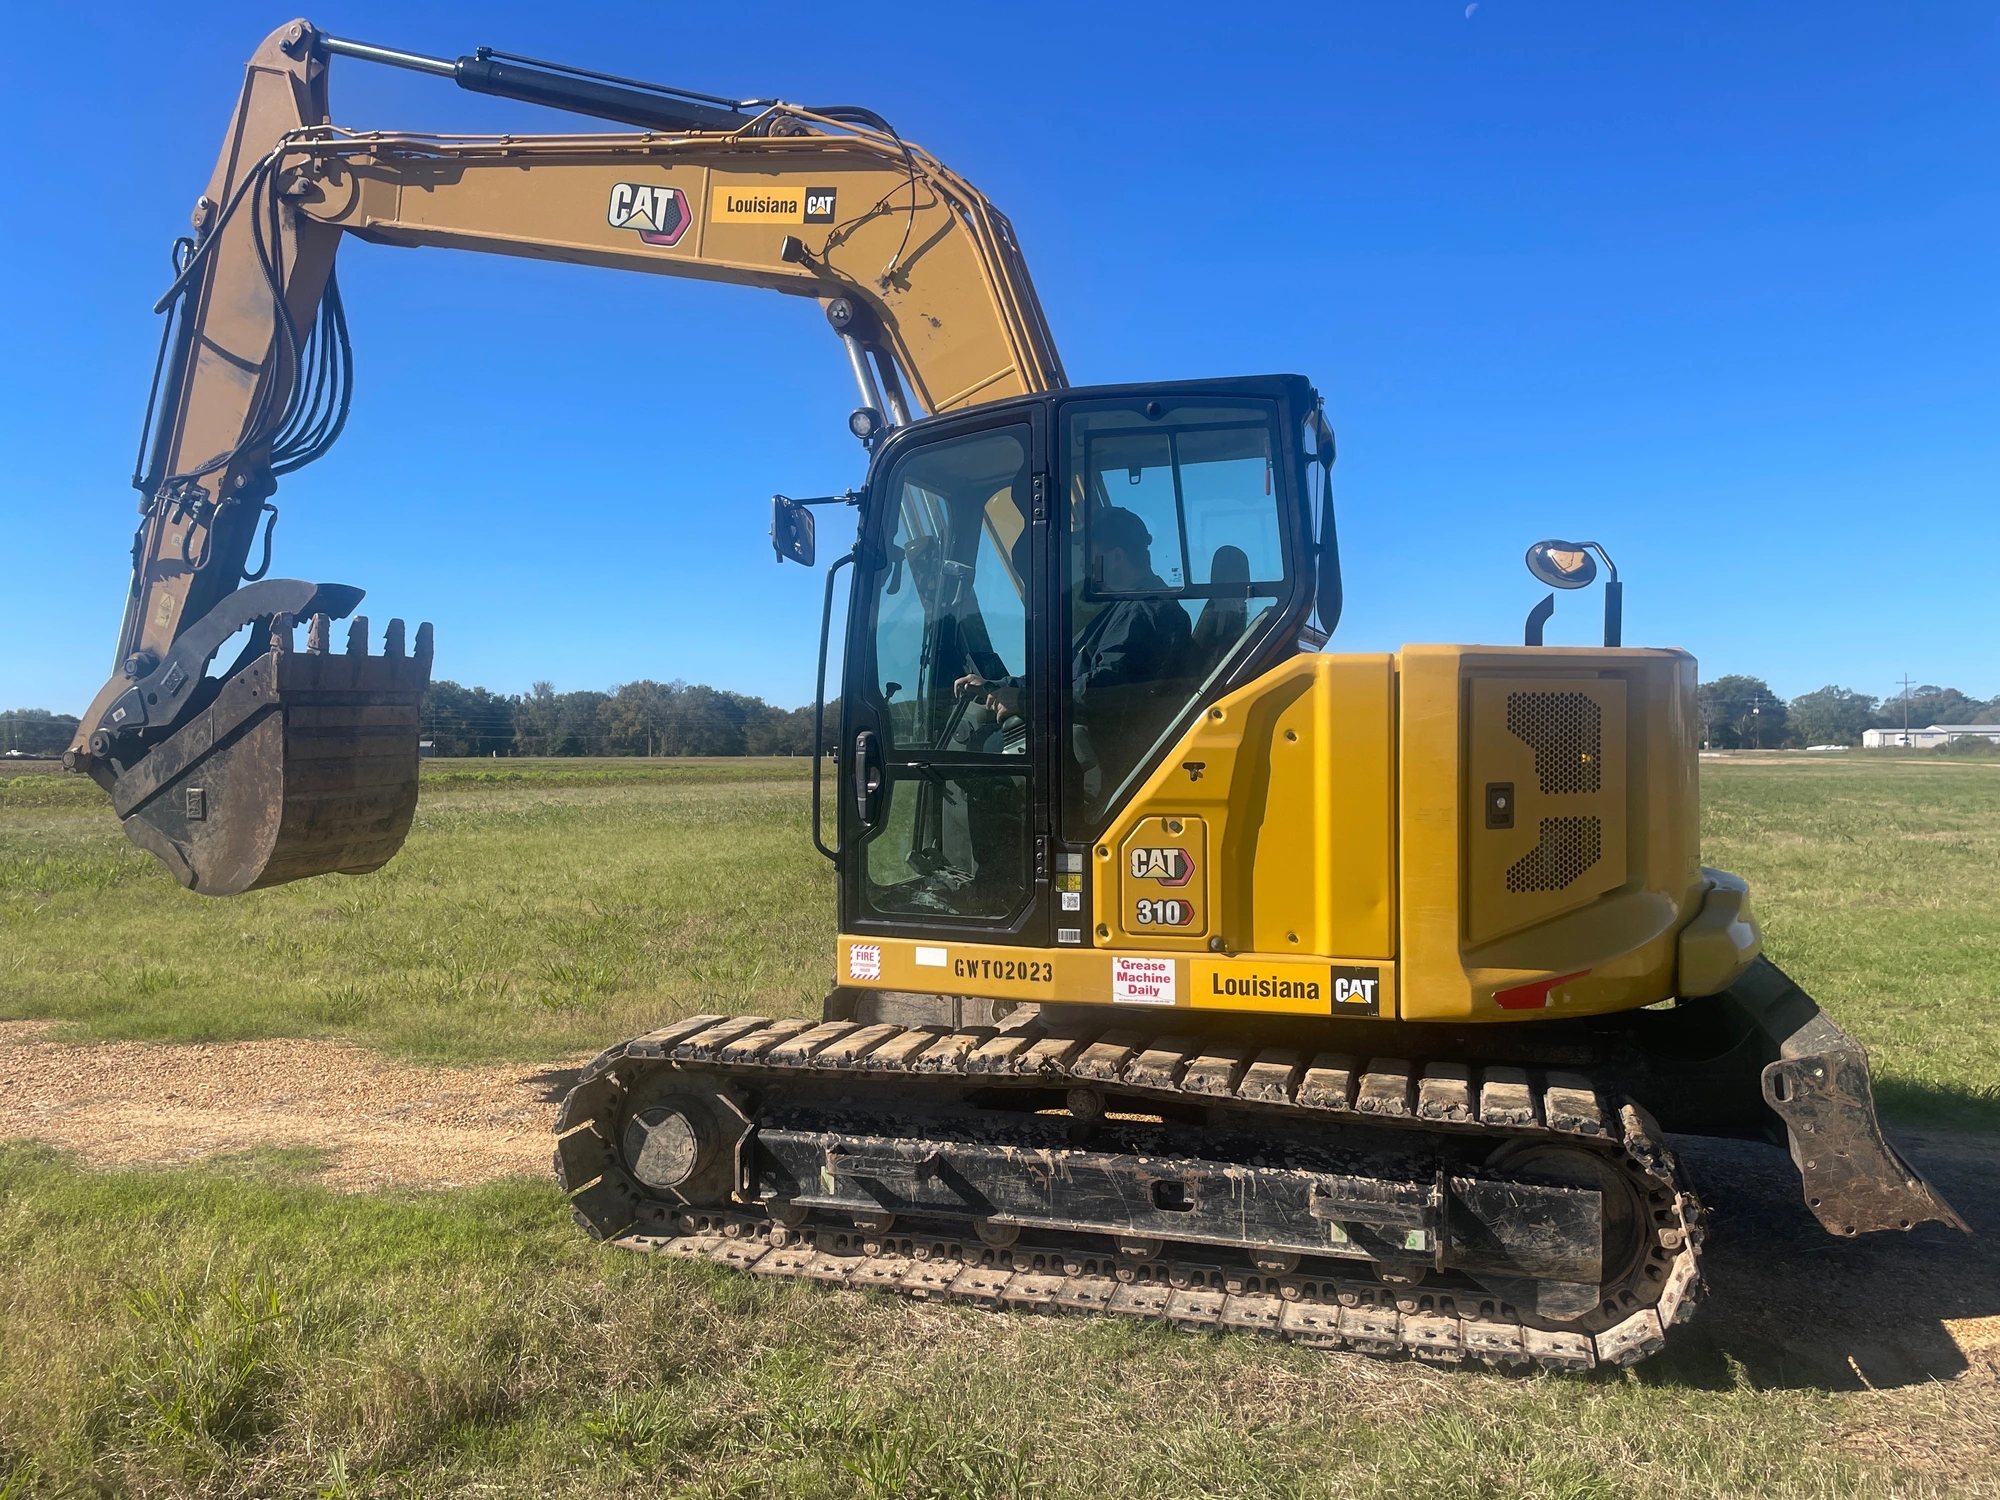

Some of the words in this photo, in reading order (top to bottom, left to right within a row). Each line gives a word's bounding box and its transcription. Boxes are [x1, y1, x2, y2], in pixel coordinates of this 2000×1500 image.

[609, 182, 675, 232] CAT
[727, 195, 798, 214] Louisiana
[807, 196, 835, 214] CAT
[1131, 849, 1178, 878] CAT
[1137, 900, 1181, 925] 310
[856, 951, 875, 962] FIRE
[1121, 959, 1166, 971] Grease
[1116, 971, 1171, 984] Machine
[1128, 984, 1160, 997] Daily
[1213, 973, 1320, 1000] Louisiana
[1335, 978, 1376, 1004] CAT
